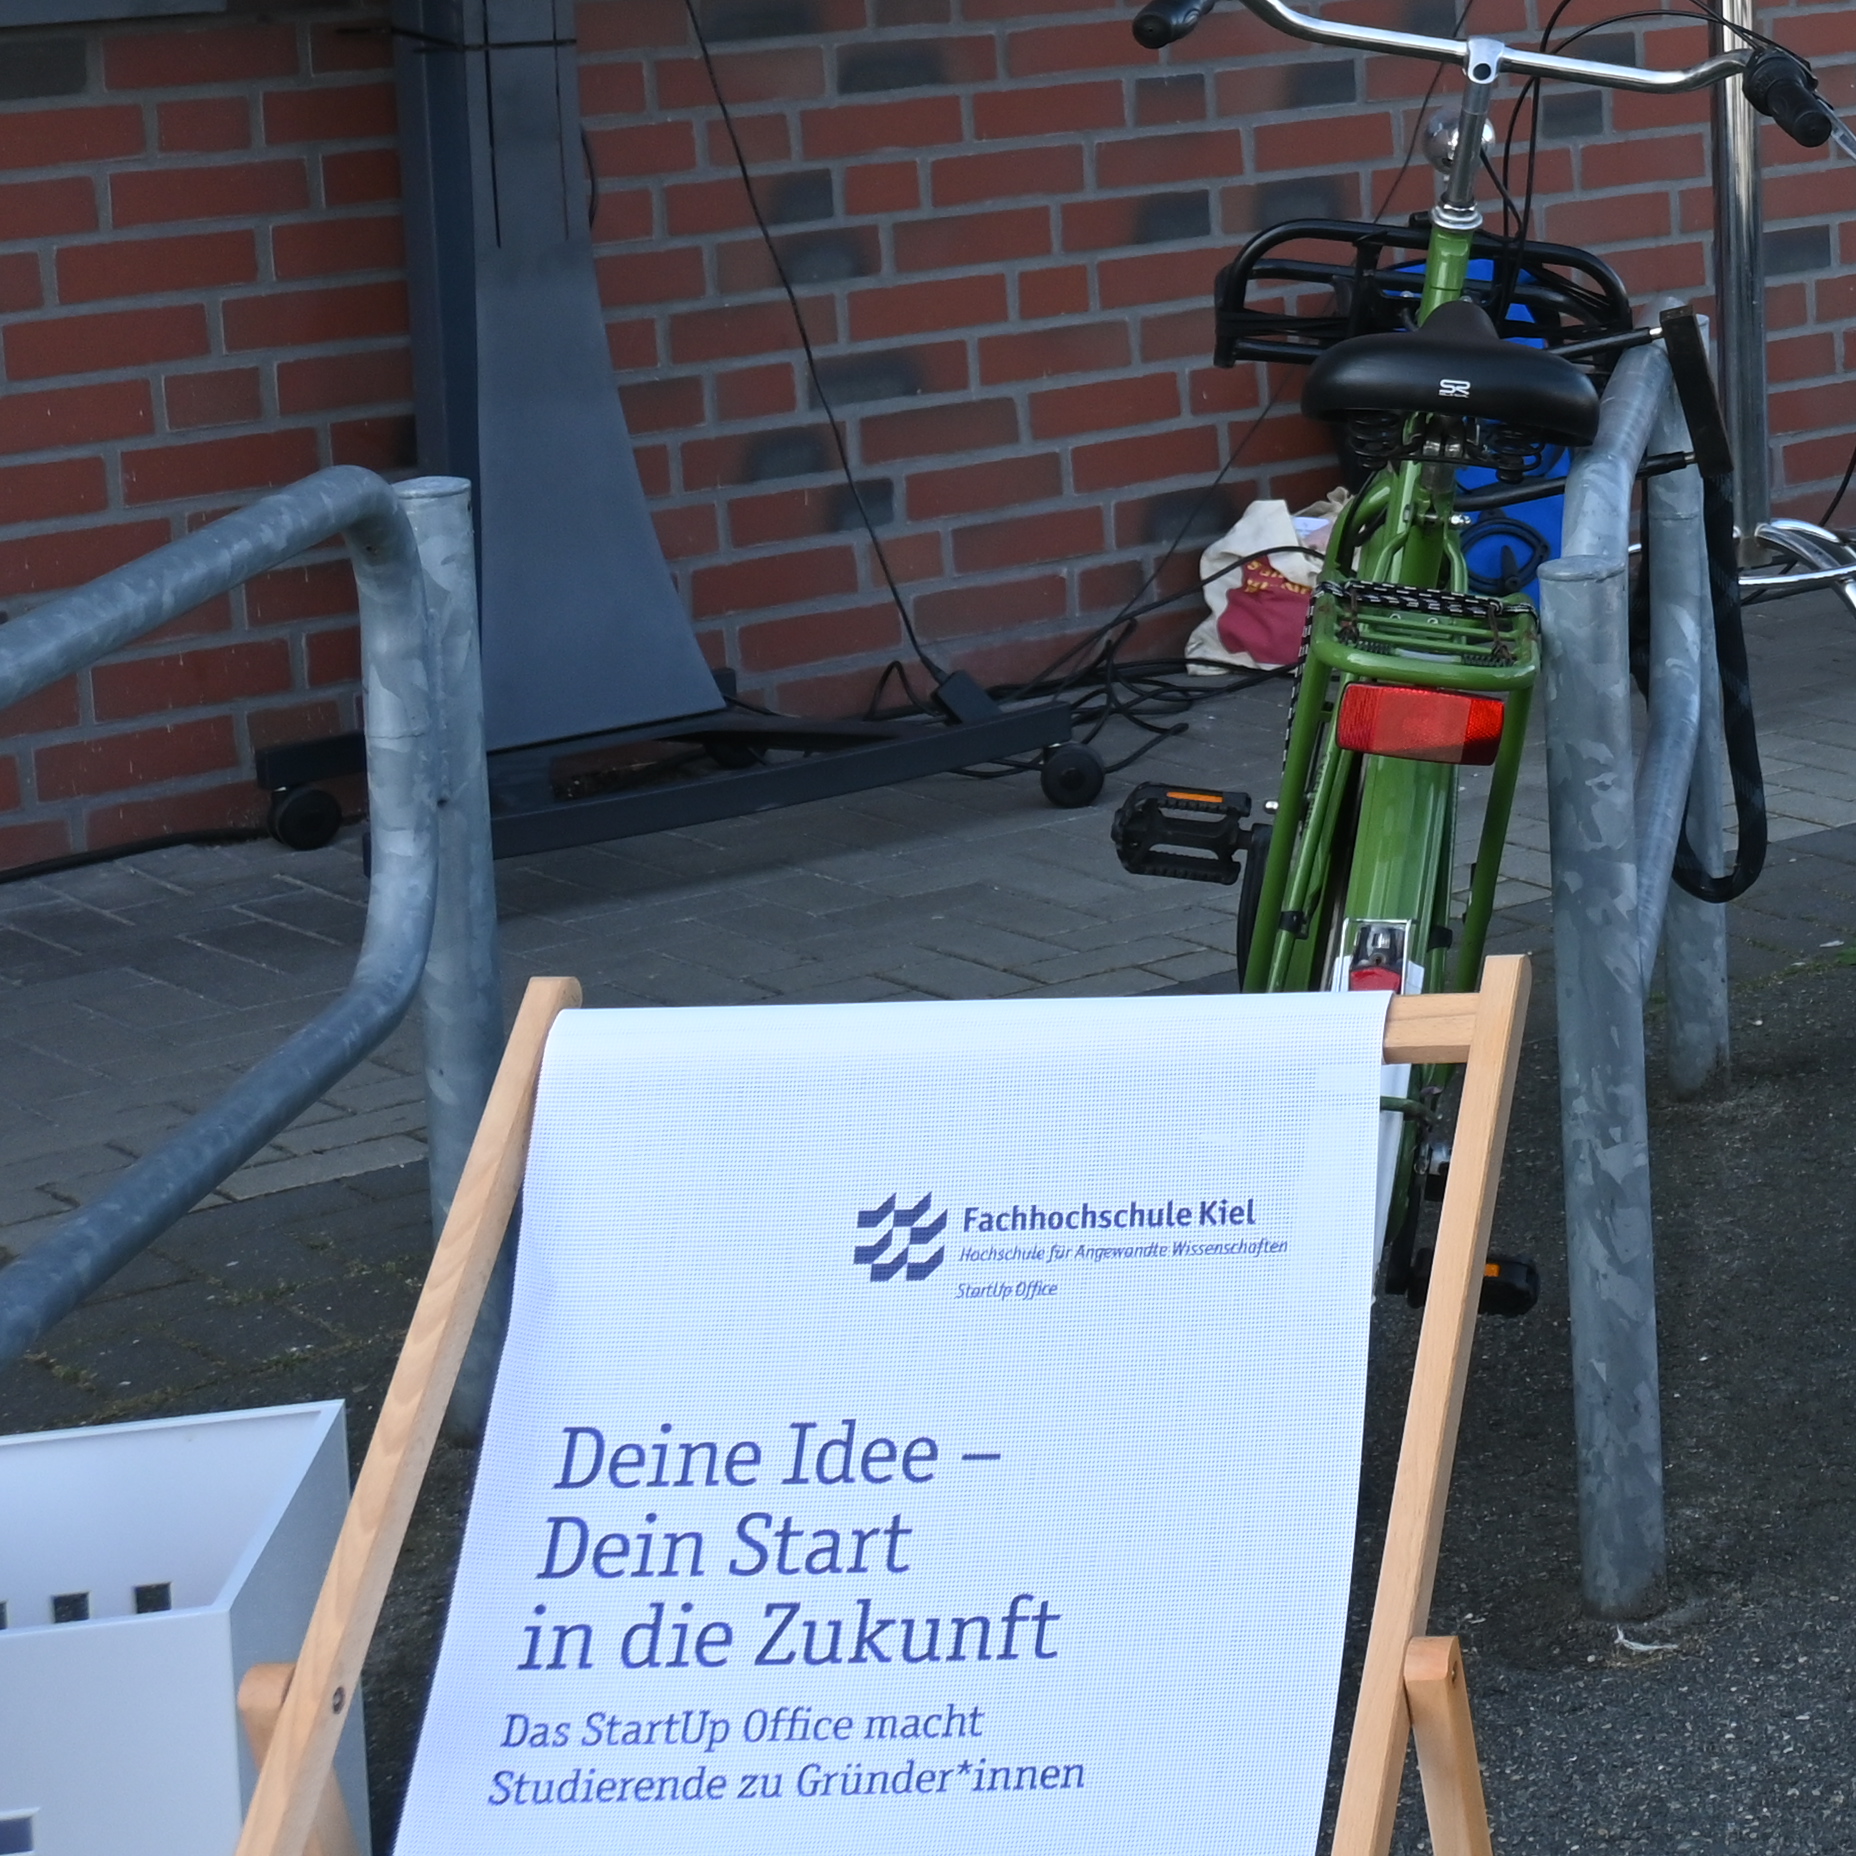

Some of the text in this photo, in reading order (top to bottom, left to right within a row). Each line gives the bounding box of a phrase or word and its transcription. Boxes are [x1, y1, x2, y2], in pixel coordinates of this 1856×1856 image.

[963, 1198, 1256, 1232] Fachhochschule Kiel
[958, 1236, 1289, 1263] Hochschule für Angewandte Wissenschaften
[954, 1280, 1058, 1301] StartUp Office
[553, 1422, 762, 1490] Deine
[781, 1419, 939, 1486] Idee
[536, 1511, 912, 1579] Dein Start
[517, 1593, 1062, 1671] in die Zukunft
[500, 1704, 985, 1752] Das StartUp Office macht
[487, 1766, 728, 1805] Studierende
[738, 1771, 783, 1799] zu
